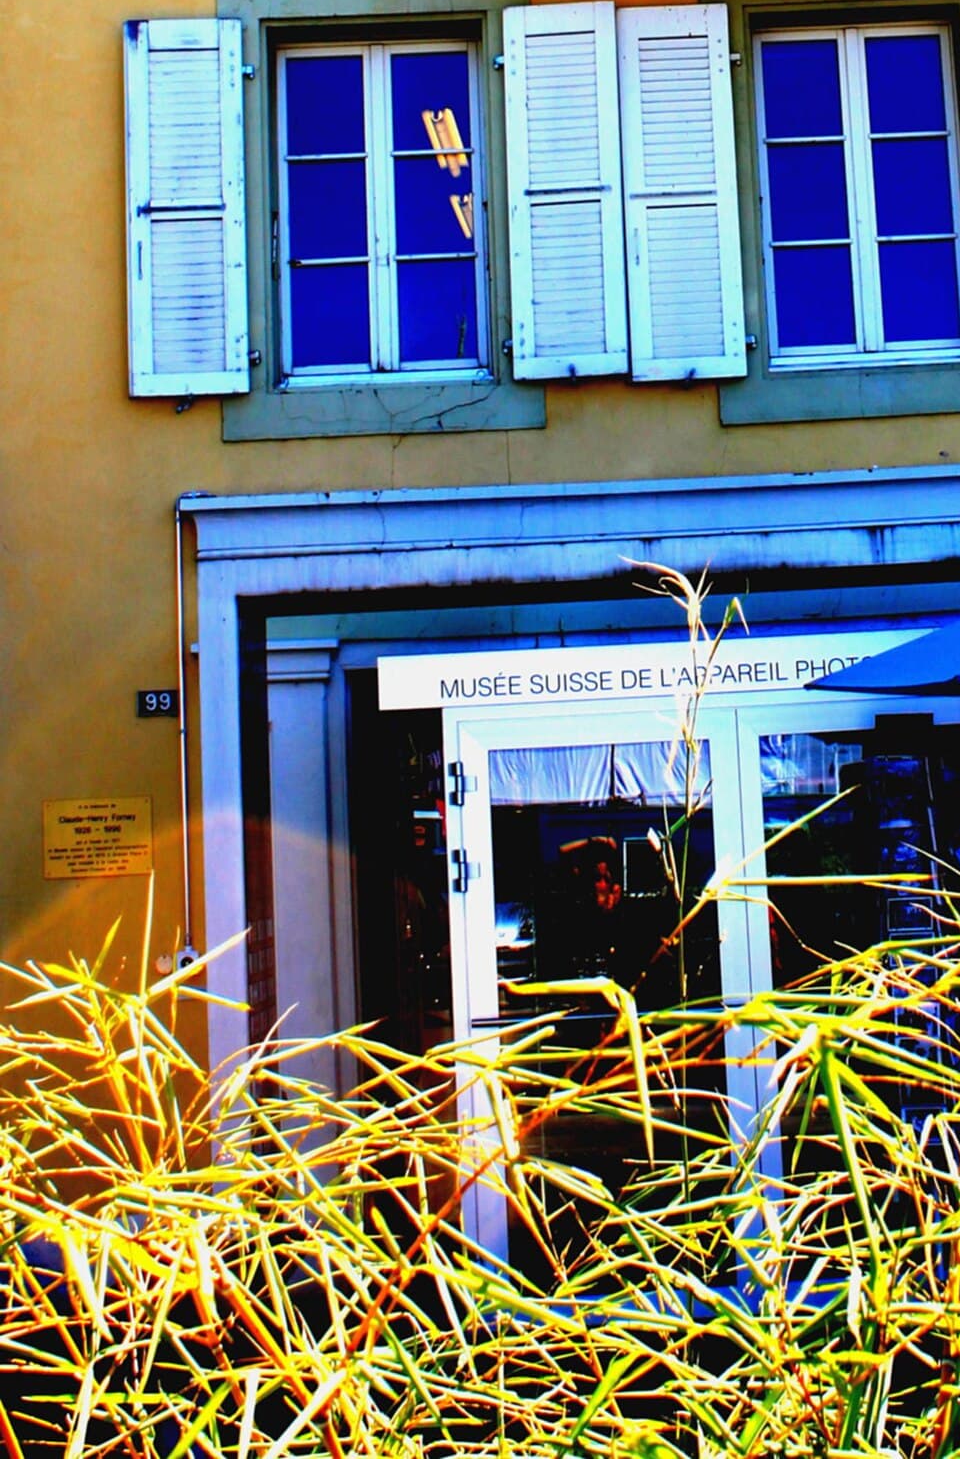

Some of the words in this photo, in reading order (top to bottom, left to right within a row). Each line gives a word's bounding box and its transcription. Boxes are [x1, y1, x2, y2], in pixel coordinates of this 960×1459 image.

[440, 671, 522, 699] MUSÉE
[529, 670, 613, 695] SUISSE
[621, 668, 653, 690] DE
[145, 692, 171, 711] 99
